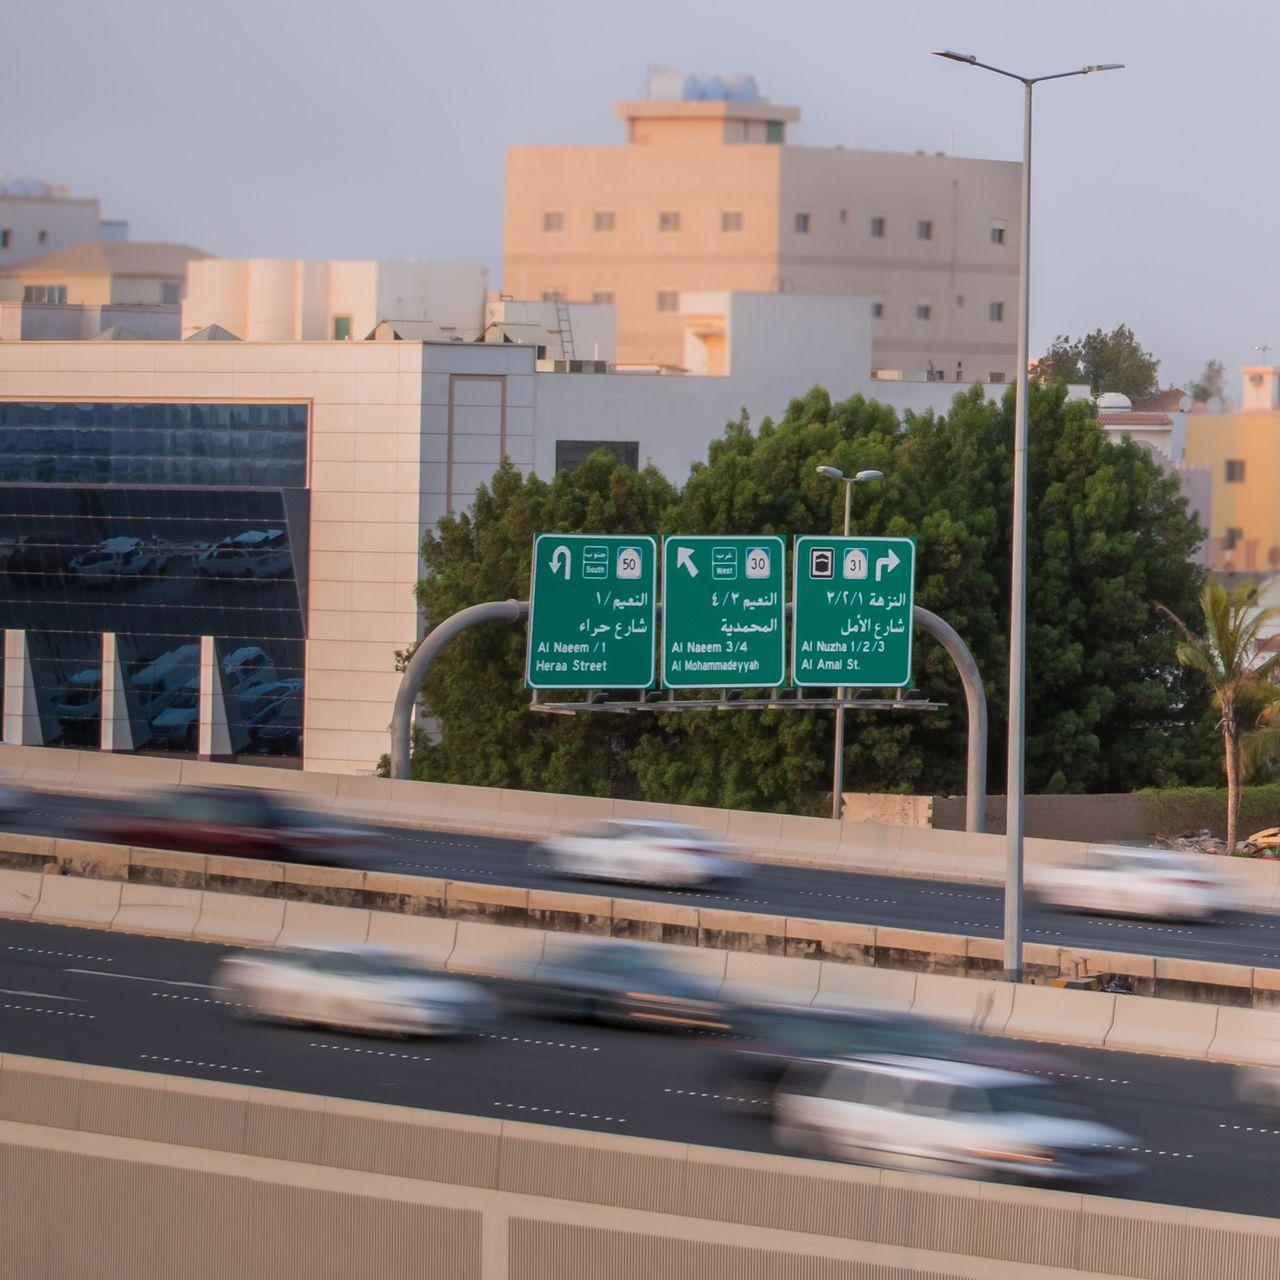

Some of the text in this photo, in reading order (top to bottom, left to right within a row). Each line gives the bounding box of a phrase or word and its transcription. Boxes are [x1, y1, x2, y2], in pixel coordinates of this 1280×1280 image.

[585, 566, 605, 574] South
[622, 558, 636, 570] 50
[751, 558, 766, 570] 30
[850, 559, 862, 572] 31
[716, 567, 733, 575] West
[612, 592, 648, 610] النعيم
[743, 592, 777, 610] النعيم
[869, 592, 906, 610] النزهة
[579, 618, 648, 640] شارع حراء
[720, 618, 777, 636] المحمدية
[840, 613, 905, 639] شارع الأمل
[537, 642, 549, 653] Al
[554, 642, 589, 653] Naeem
[671, 642, 683, 653] Al
[687, 642, 722, 653] Naeem
[801, 641, 813, 652] Al
[817, 641, 847, 652] Nuzha
[536, 660, 608, 672] Heraa Street
[671, 659, 760, 673] Al Mohammadeyyah
[801, 658, 861, 670] Al Amal St.
